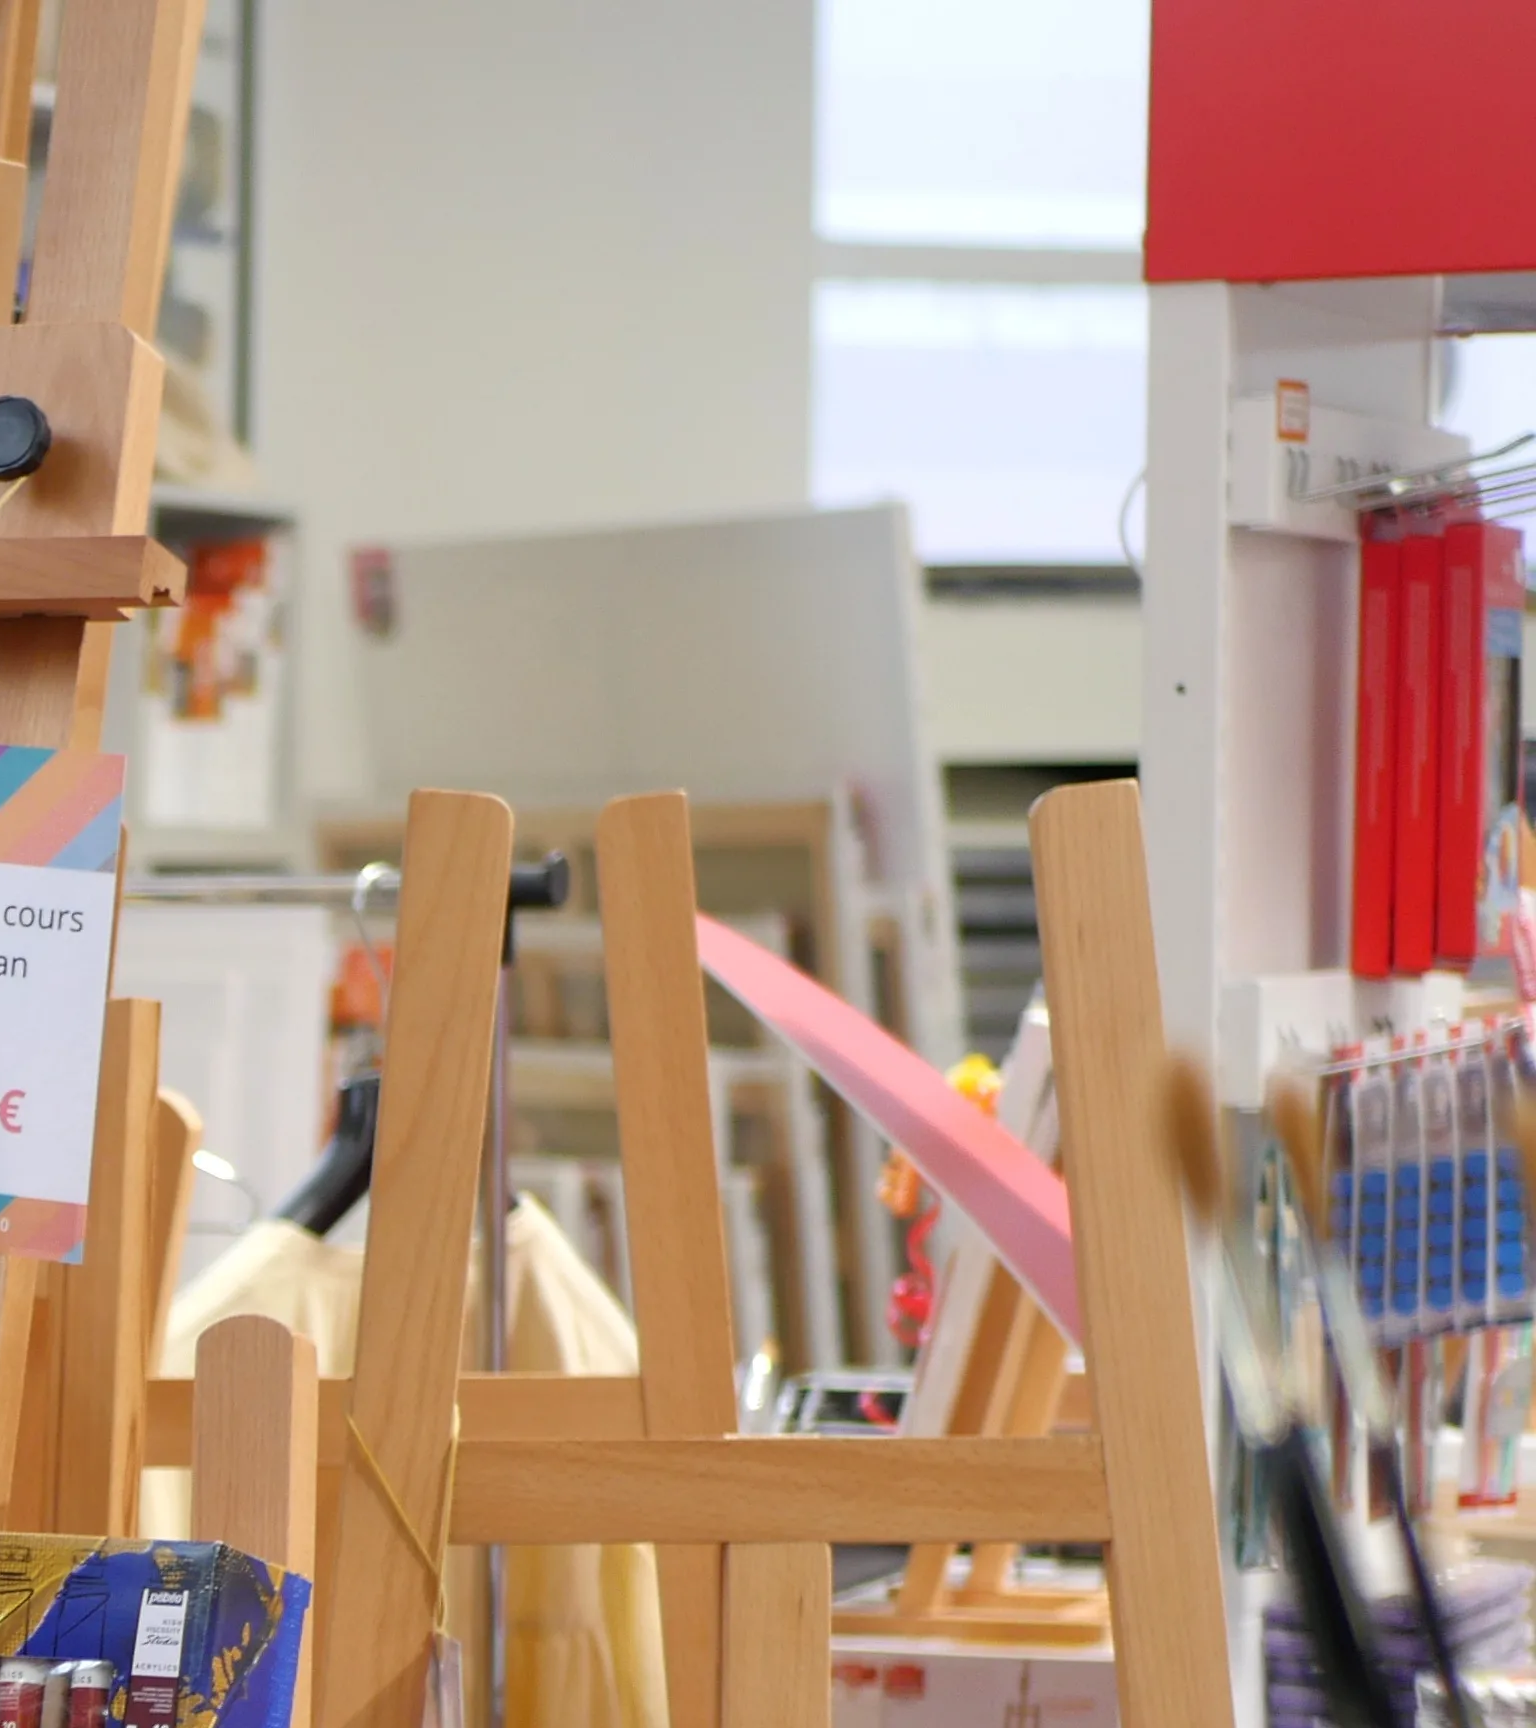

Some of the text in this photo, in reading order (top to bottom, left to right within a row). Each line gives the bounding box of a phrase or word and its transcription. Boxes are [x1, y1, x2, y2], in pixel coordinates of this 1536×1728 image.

[3, 901, 85, 933] cours
[141, 1635, 179, 1646] Studio
[135, 1662, 178, 1672] ACRYLICS
